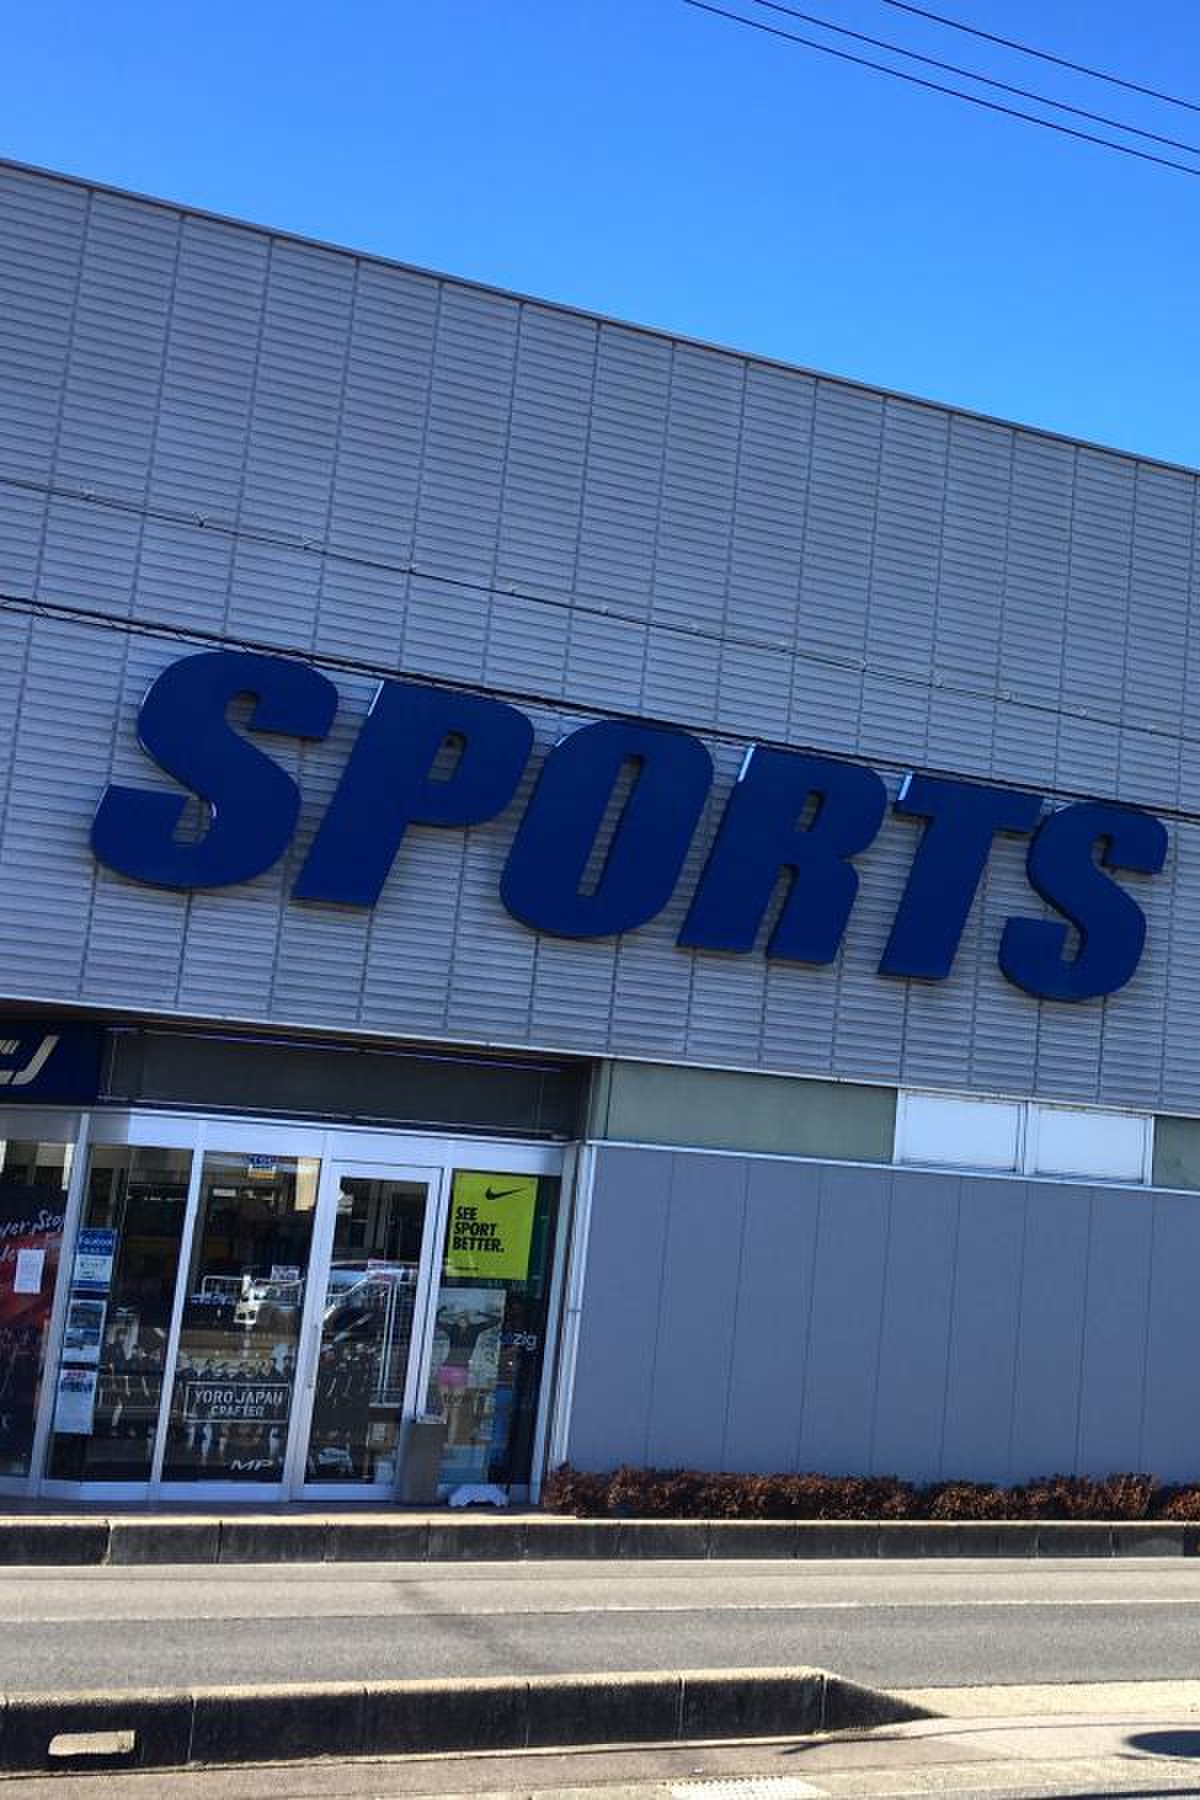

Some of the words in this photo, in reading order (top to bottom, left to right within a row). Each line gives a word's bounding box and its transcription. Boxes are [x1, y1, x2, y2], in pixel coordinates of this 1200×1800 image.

[90, 651, 1169, 1001] SPORTS
[455, 1205, 478, 1220] SEE
[454, 1222, 497, 1237] SPORT
[452, 1236, 504, 1253] BETTER.
[195, 1390, 234, 1405] YORO
[235, 1391, 284, 1405] JAPAN
